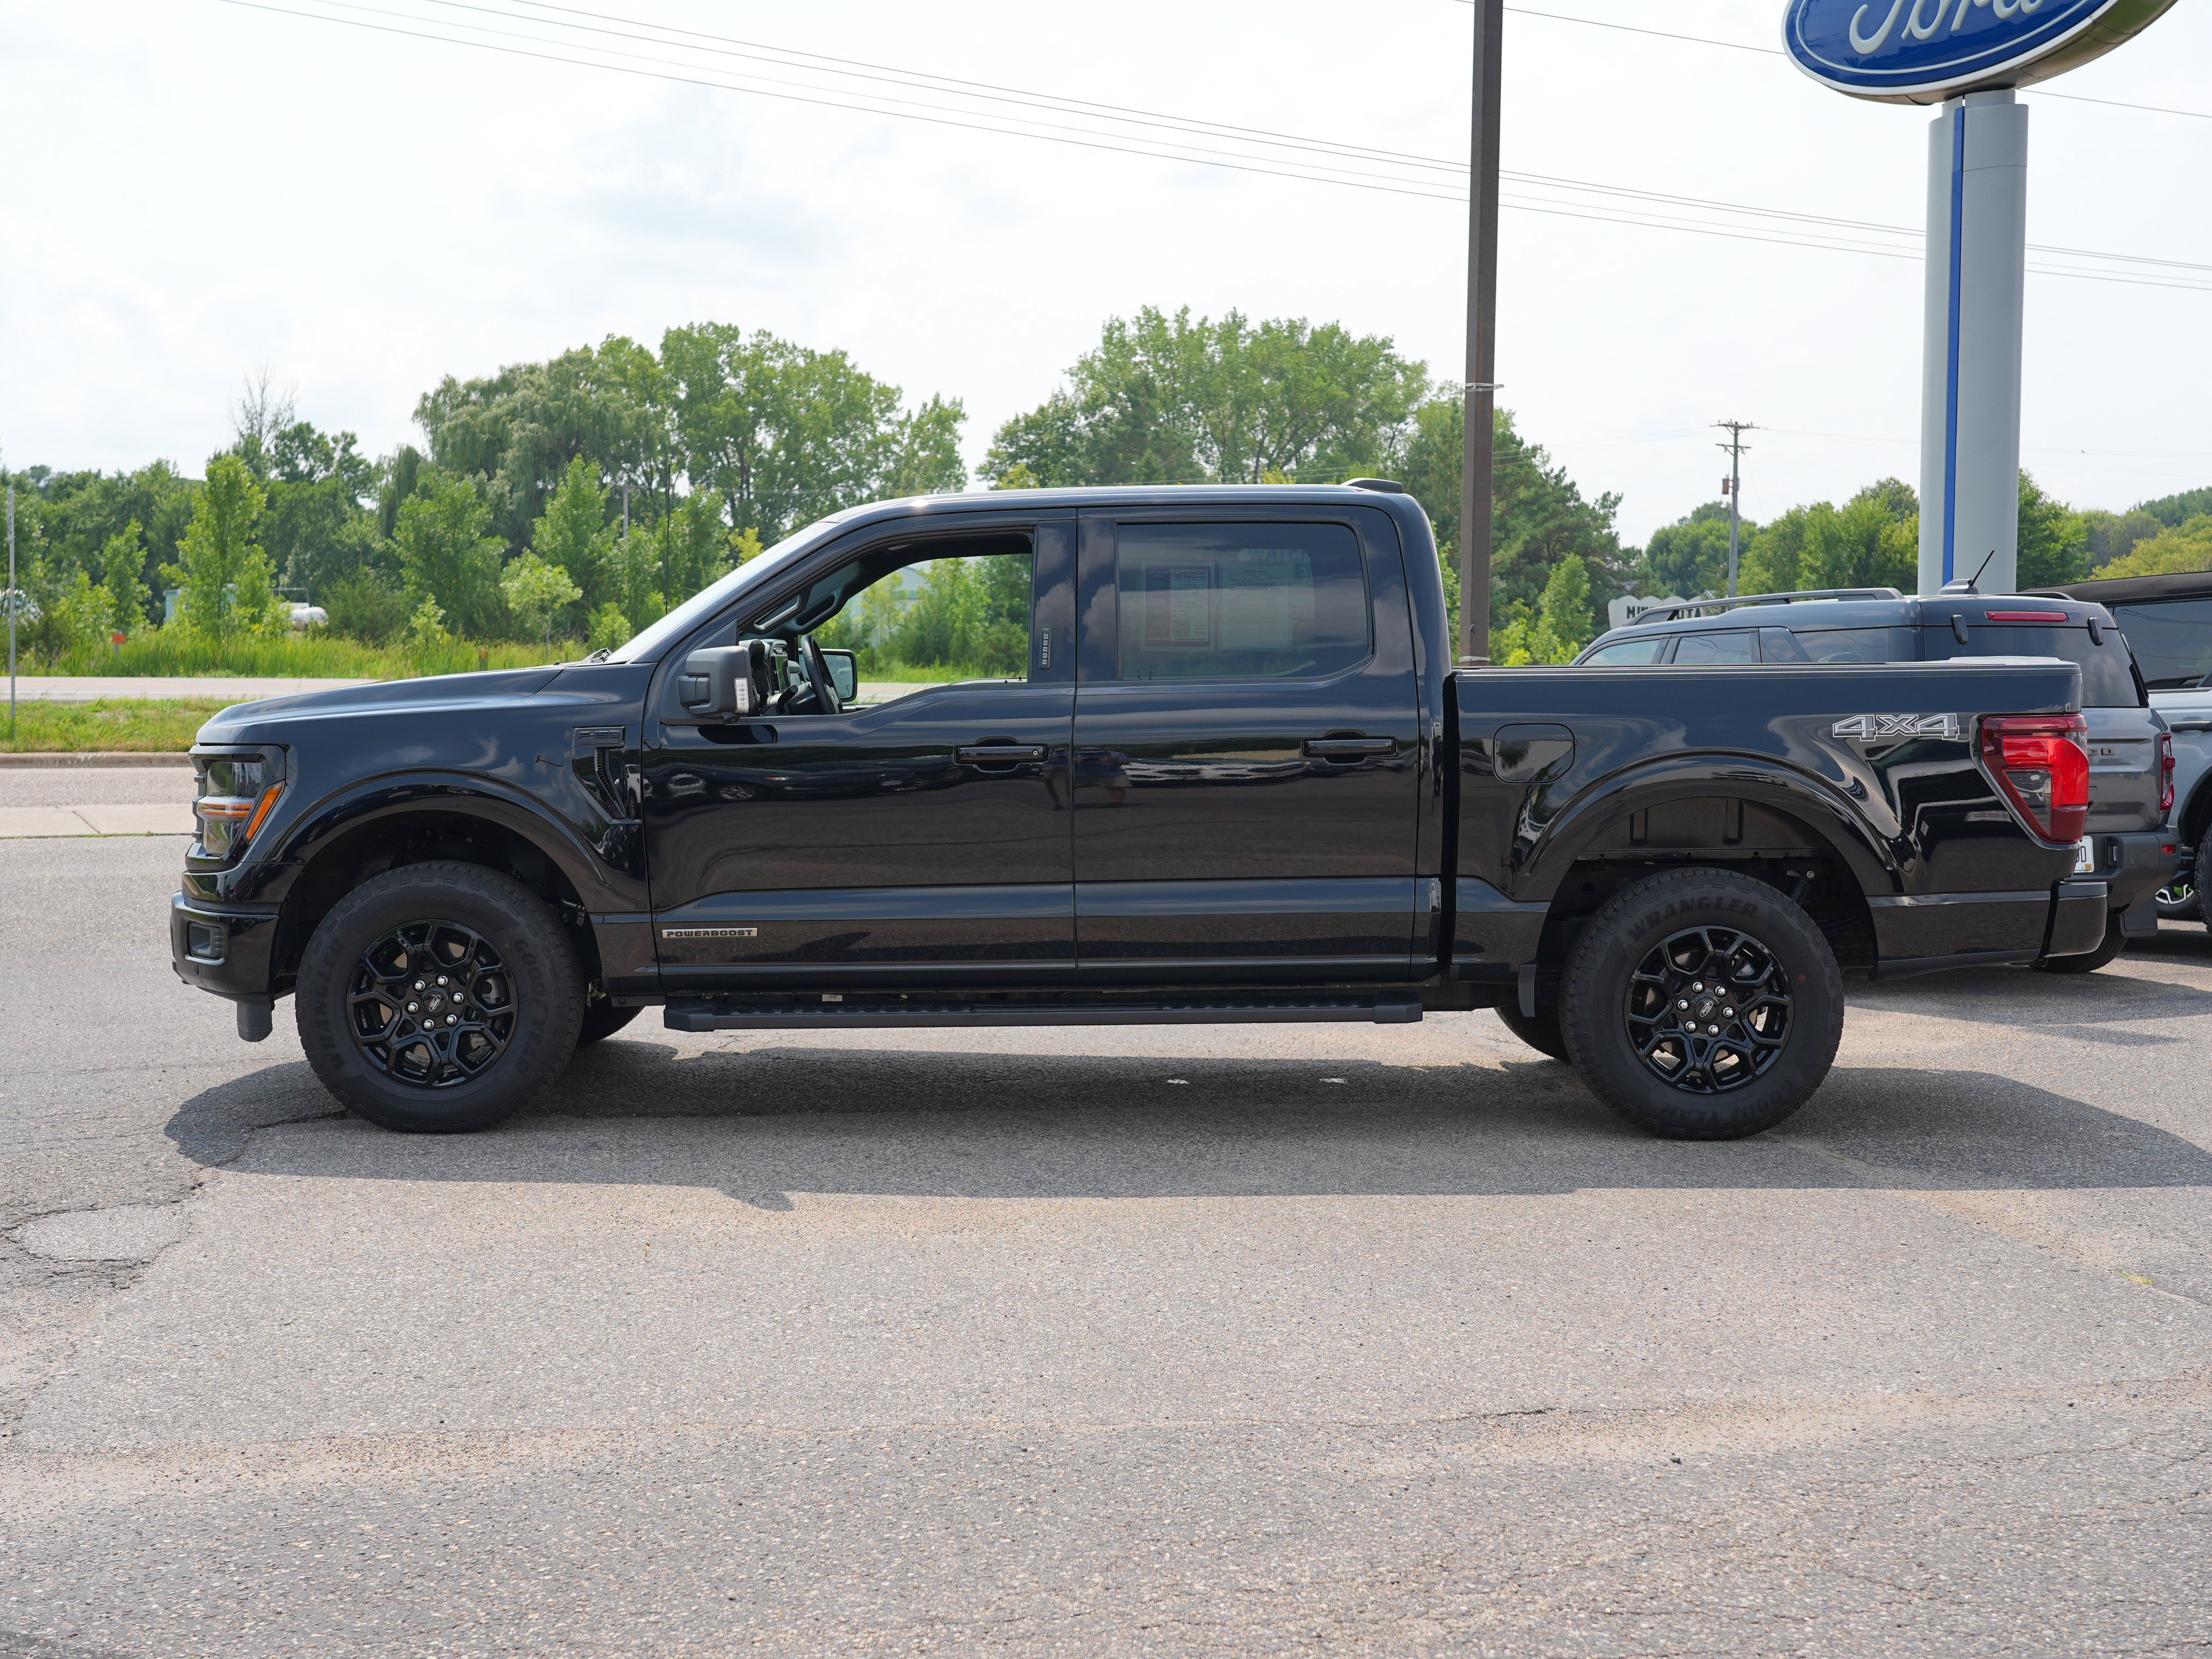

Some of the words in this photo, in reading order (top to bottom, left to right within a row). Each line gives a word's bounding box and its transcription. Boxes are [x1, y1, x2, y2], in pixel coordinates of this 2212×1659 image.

[1849, 0, 2045, 55] For
[578, 730, 621, 739] F-150
[1832, 713, 1959, 741] 4X4
[1628, 896, 1759, 941] WRANGLER
[314, 938, 346, 1070] WRANGLER
